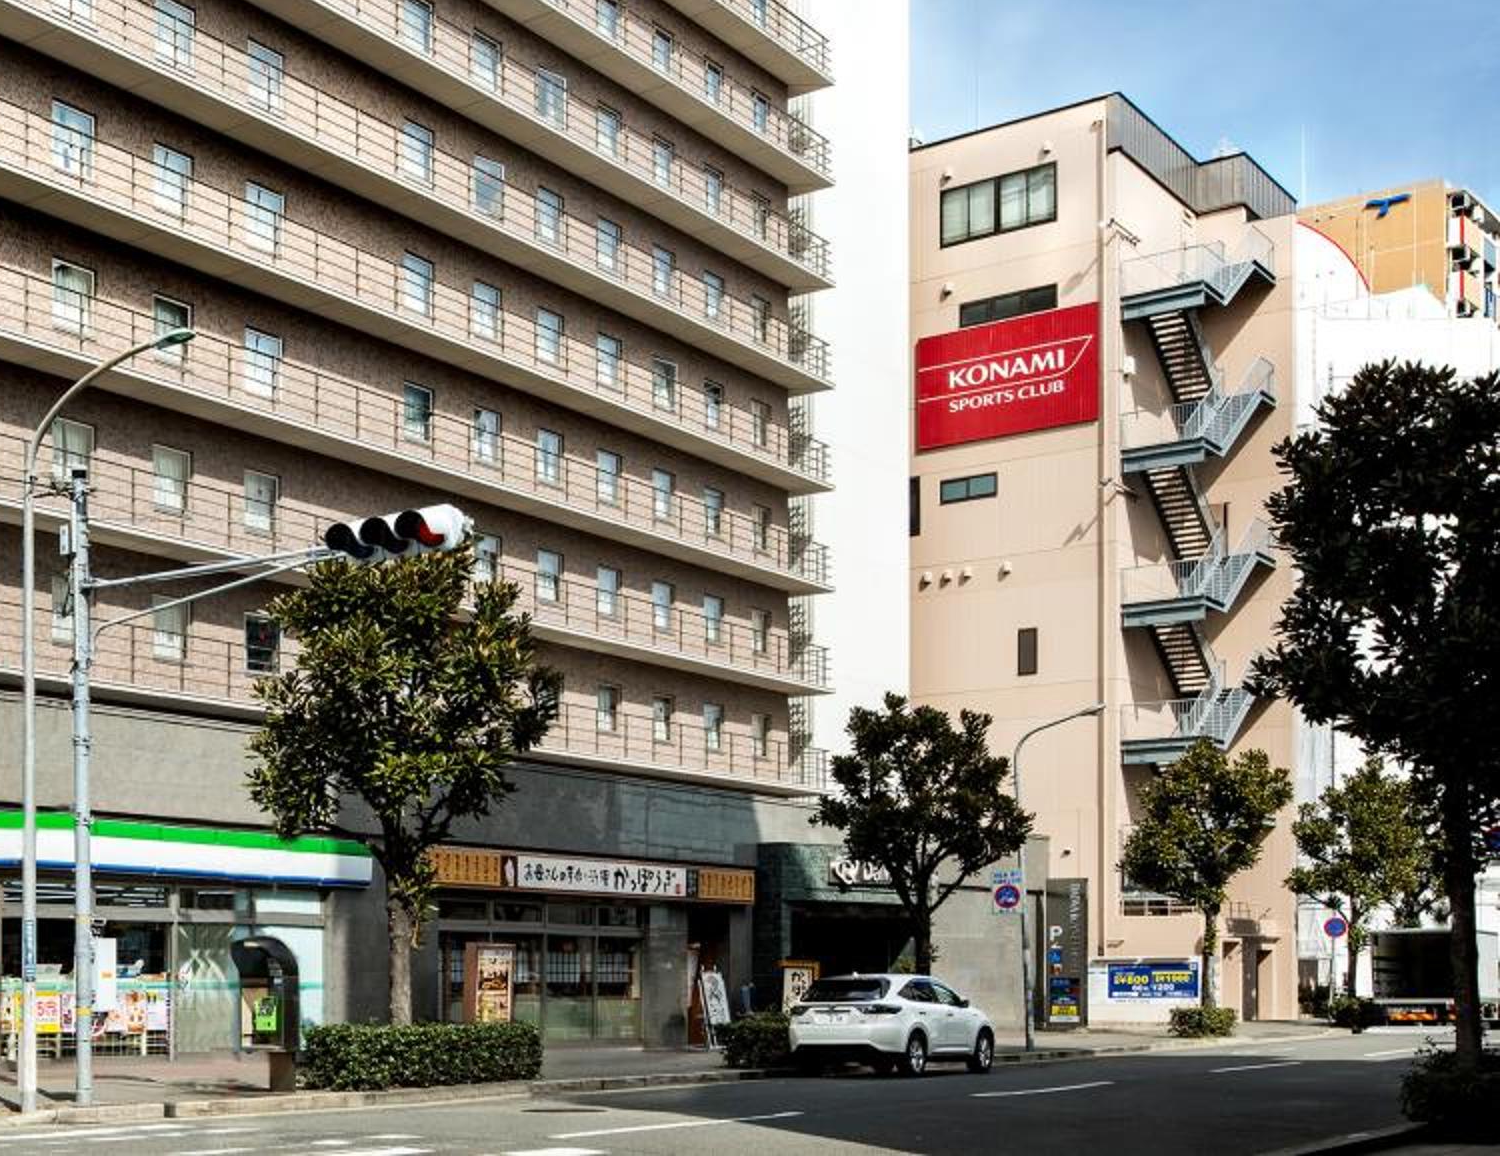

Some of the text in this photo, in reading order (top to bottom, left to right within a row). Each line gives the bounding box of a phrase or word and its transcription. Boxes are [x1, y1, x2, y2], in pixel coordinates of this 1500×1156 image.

[949, 349, 1065, 389] KONAMI
[949, 379, 1065, 412] SPORTS CLUB
[1050, 925, 1063, 941] P
